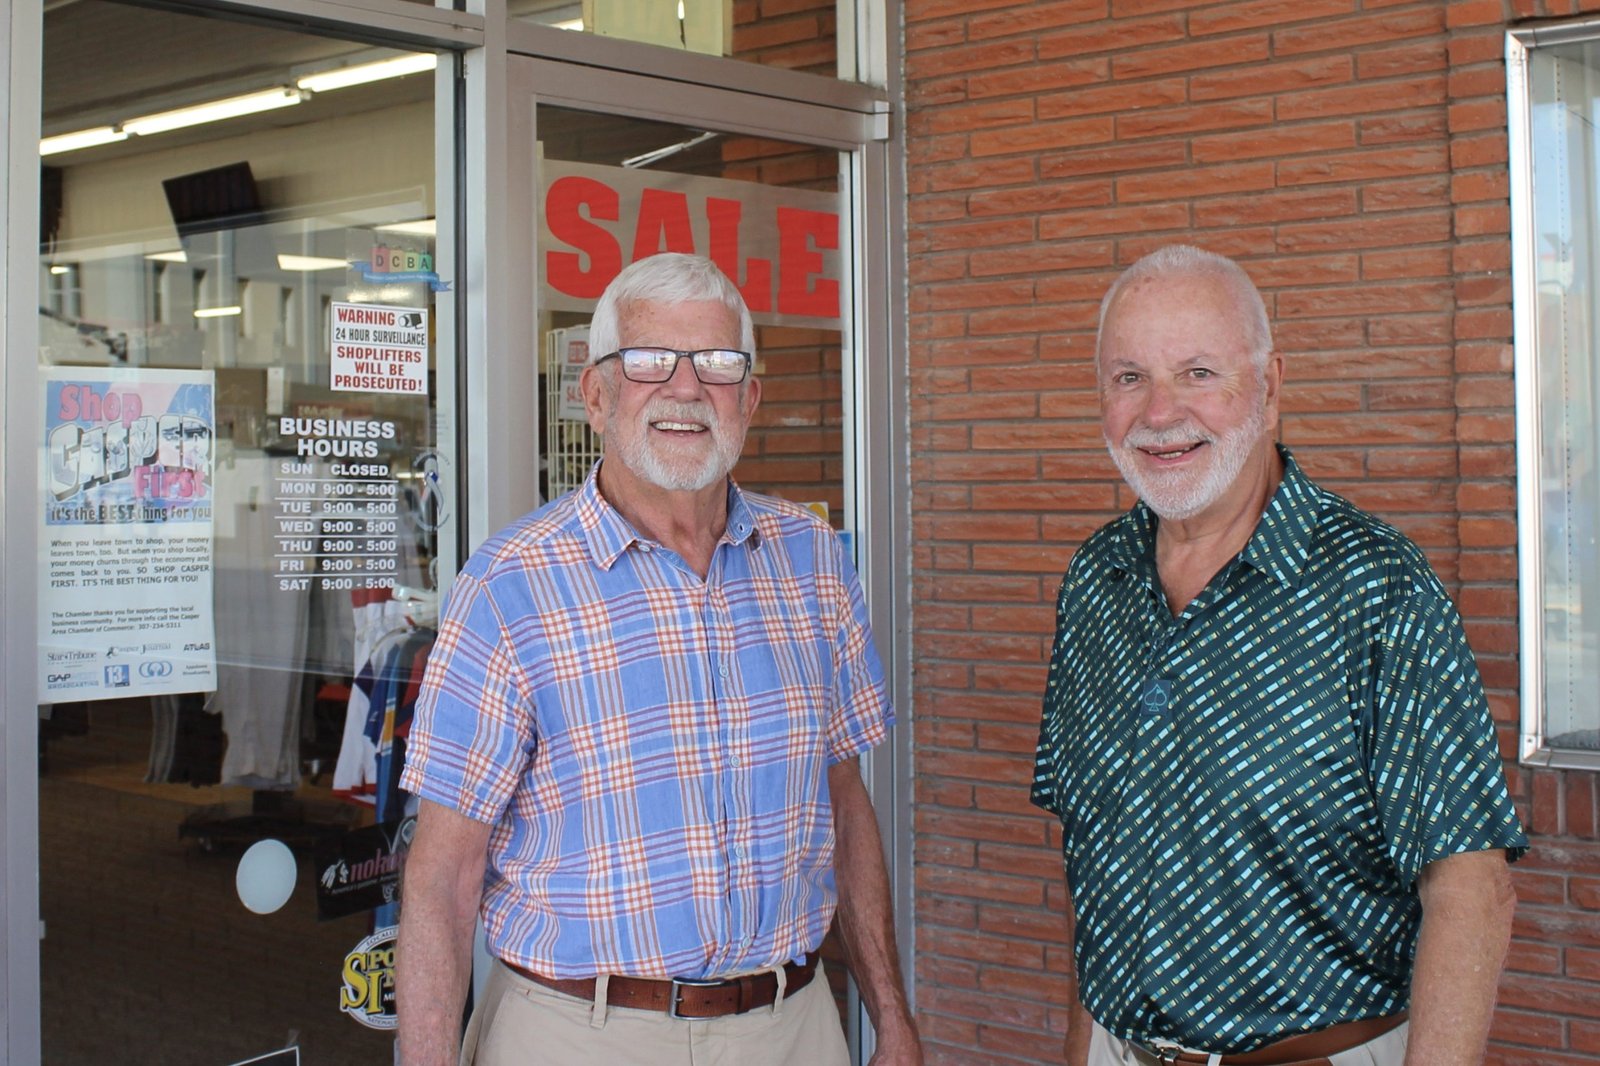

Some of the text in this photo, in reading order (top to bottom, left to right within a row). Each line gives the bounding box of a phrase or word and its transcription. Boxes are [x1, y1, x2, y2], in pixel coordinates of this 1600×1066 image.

[545, 176, 840, 318] SALE
[338, 308, 395, 326] WARNING
[336, 327, 425, 346] 24 HOUR SURVEILLANCE
[337, 346, 422, 363] SHOPLIFTERS
[354, 361, 404, 376] WILL BE
[335, 374, 422, 391] PROSECUTED!
[58, 384, 143, 429] Shop
[280, 417, 395, 439] BUSINESS
[297, 438, 378, 458] HOURS
[281, 463, 389, 476] SUN CLOSED
[134, 465, 208, 498] First
[280, 483, 316, 494] MON
[323, 484, 354, 495] 9:00
[366, 484, 396, 495] 5:00
[51, 508, 71, 521] it's
[74, 506, 95, 520] the
[98, 505, 135, 520] BEST
[280, 502, 311, 513] TUE
[323, 502, 354, 514] 9:00
[366, 502, 396, 514] 5:00
[280, 521, 314, 532] WED
[322, 521, 354, 532] 9:00
[366, 521, 396, 532] 5:00
[280, 541, 312, 552] THU
[323, 540, 354, 552] 9:00
[366, 540, 396, 552] 5:00
[137, 566, 147, 574] SO
[154, 565, 175, 573] SHOP
[181, 564, 209, 572] CASPER
[280, 560, 304, 571] FRI
[322, 559, 353, 571] 9:00
[366, 559, 395, 570] 5:00
[137, 576, 162, 584] THING
[164, 575, 179, 583] FOR
[280, 579, 309, 591] SAT
[321, 578, 352, 590] 9:00
[365, 577, 395, 589] 5:00
[183, 643, 210, 651] ATLAS
[48, 673, 71, 683] GAP
